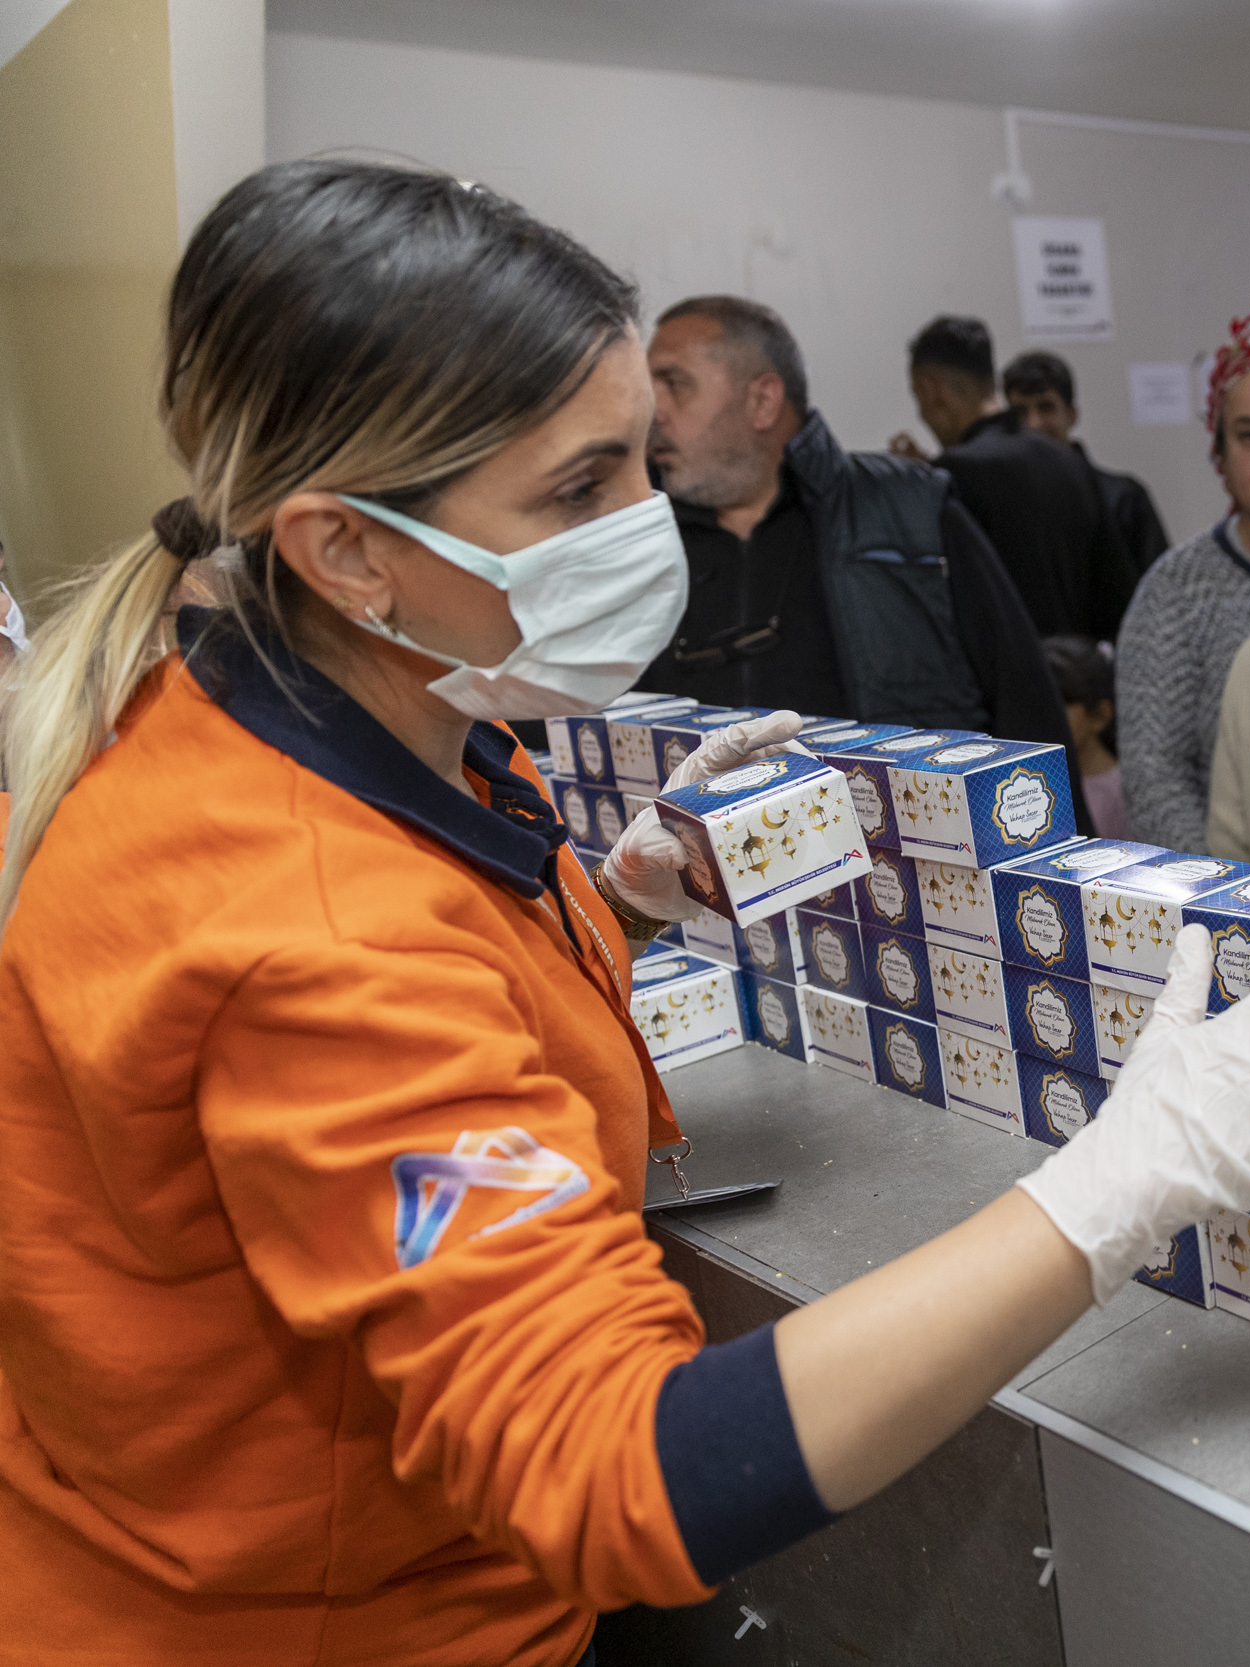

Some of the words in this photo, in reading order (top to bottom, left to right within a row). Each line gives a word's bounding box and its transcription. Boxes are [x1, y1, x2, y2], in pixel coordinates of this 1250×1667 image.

[1007, 787, 1039, 802] Kandilimiz
[1026, 906, 1053, 918] Kandilimiz
[1036, 1000, 1062, 1014] Kandilimiz
[1050, 1089, 1078, 1104] Kandilimiz
